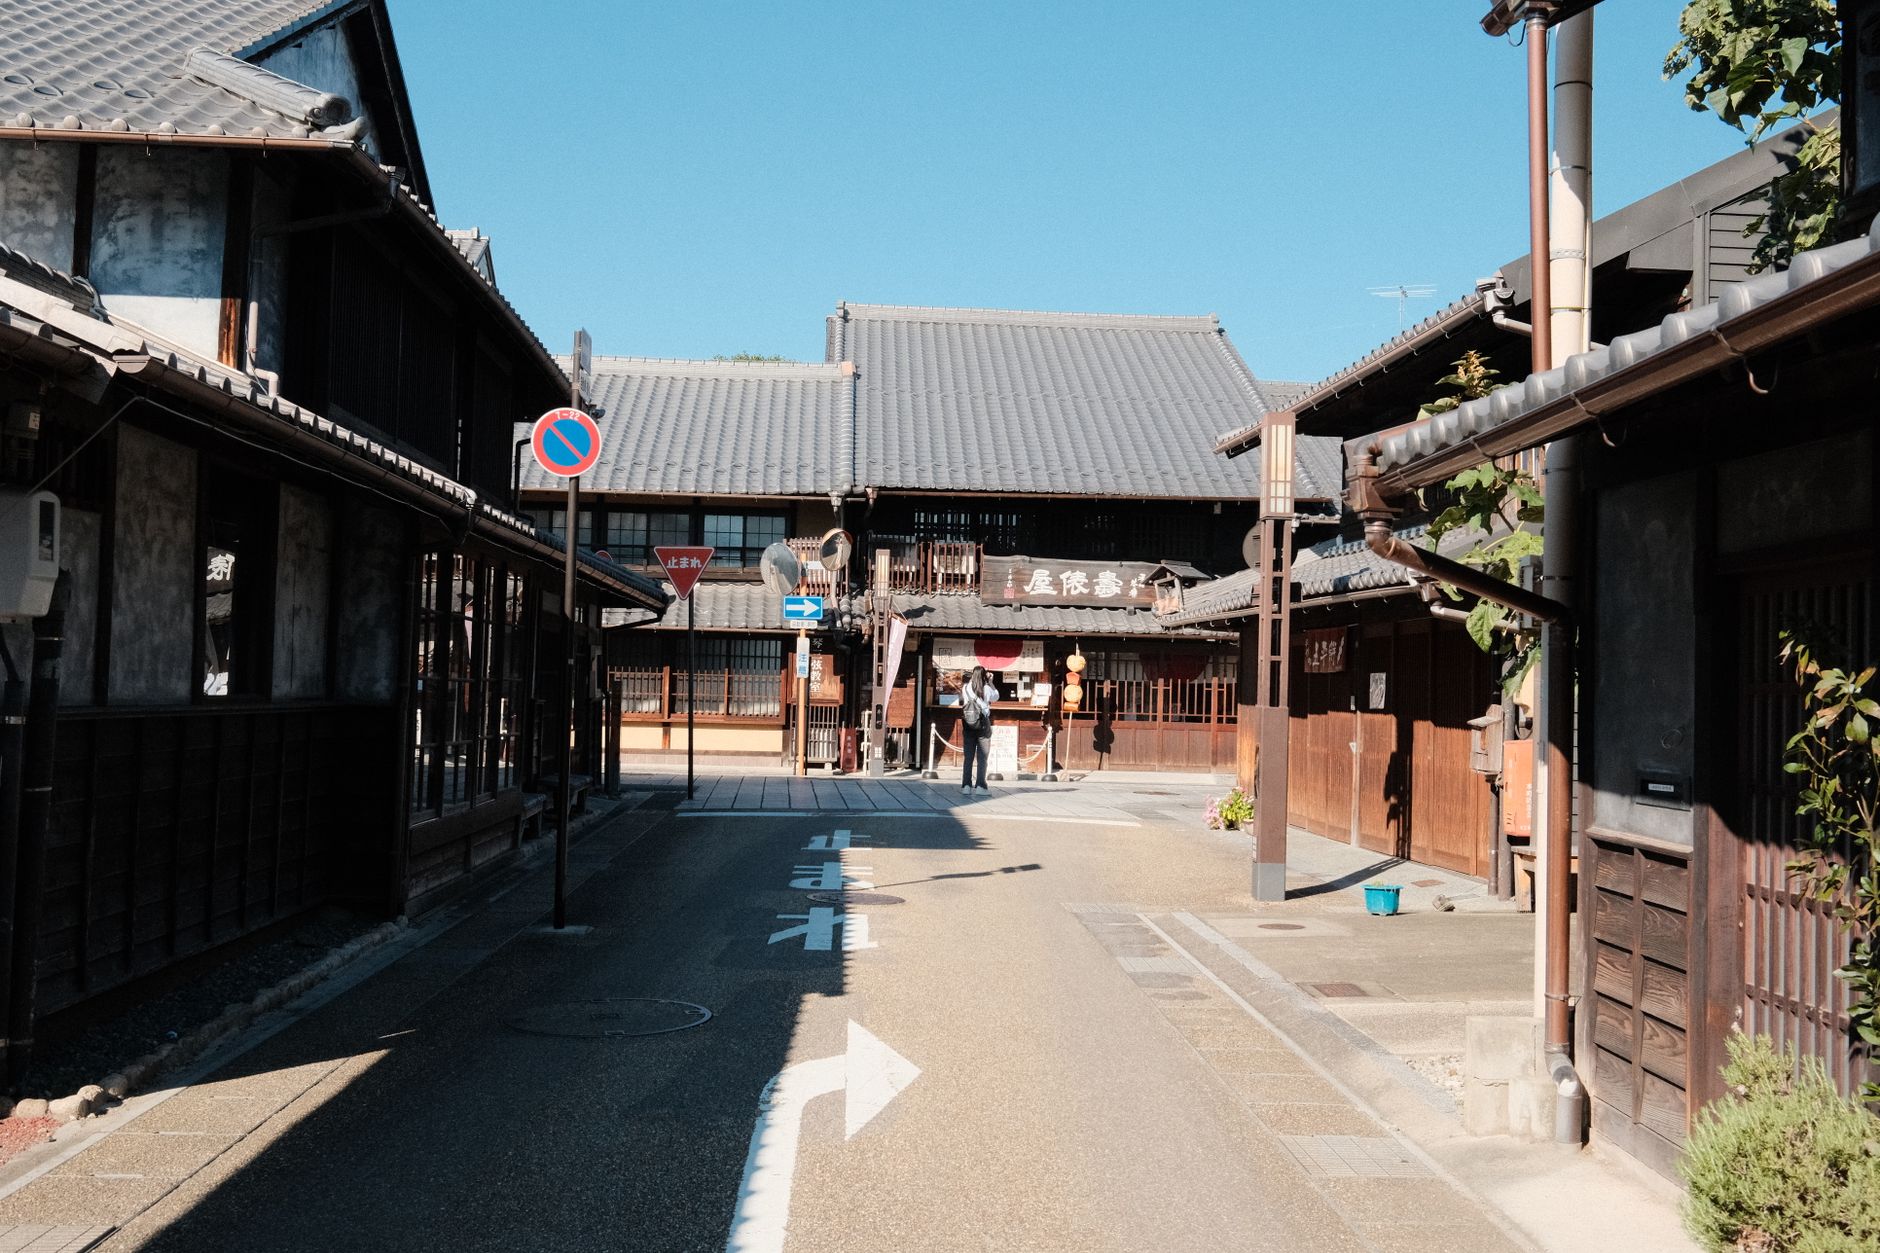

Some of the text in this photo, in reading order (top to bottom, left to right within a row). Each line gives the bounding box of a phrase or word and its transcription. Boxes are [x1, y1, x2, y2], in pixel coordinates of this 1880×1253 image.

[555, 411, 580, 421] 7-22
[666, 556, 703, 569] 止まれ
[767, 829, 879, 951] 止まれ
